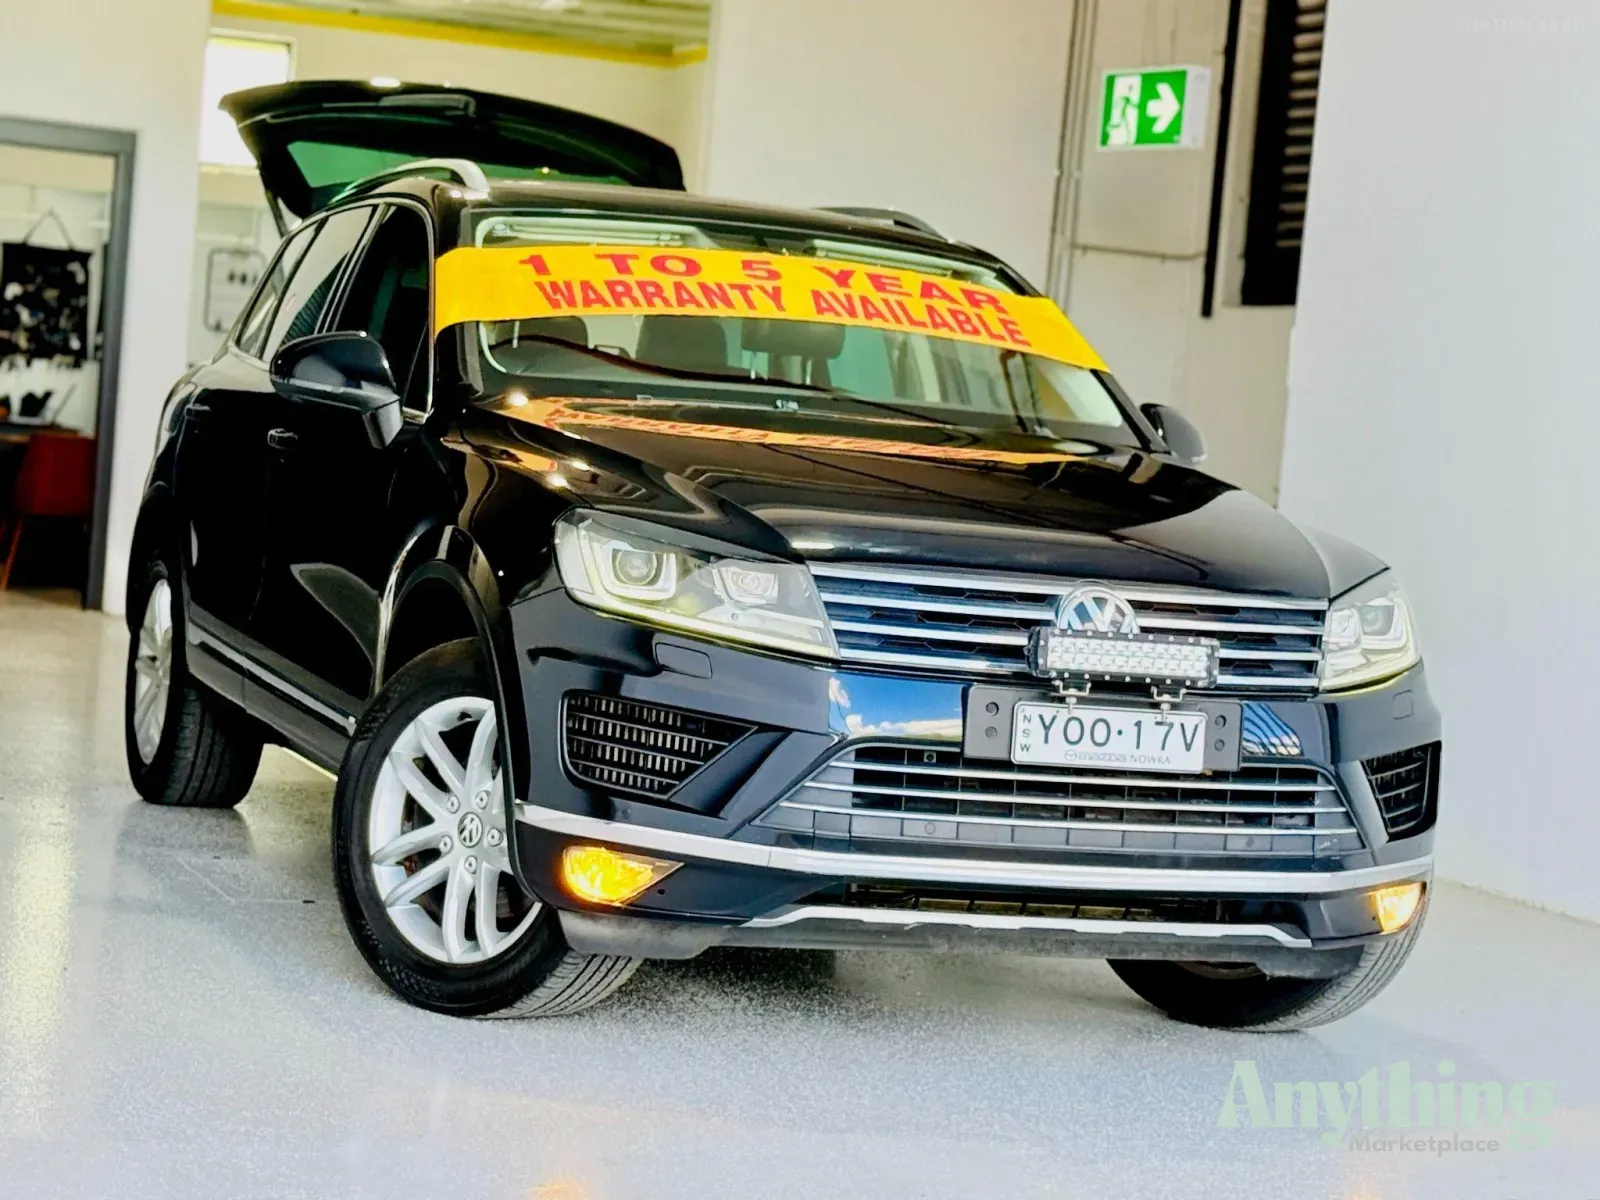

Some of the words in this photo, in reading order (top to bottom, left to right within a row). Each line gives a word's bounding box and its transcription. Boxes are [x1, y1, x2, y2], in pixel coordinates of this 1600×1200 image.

[519, 254, 551, 275] 1
[595, 253, 702, 277] TO
[741, 260, 783, 281] 5
[812, 265, 1010, 313] YEAR
[533, 280, 786, 312] WARRANTY
[811, 289, 1031, 346] AVAILABLE
